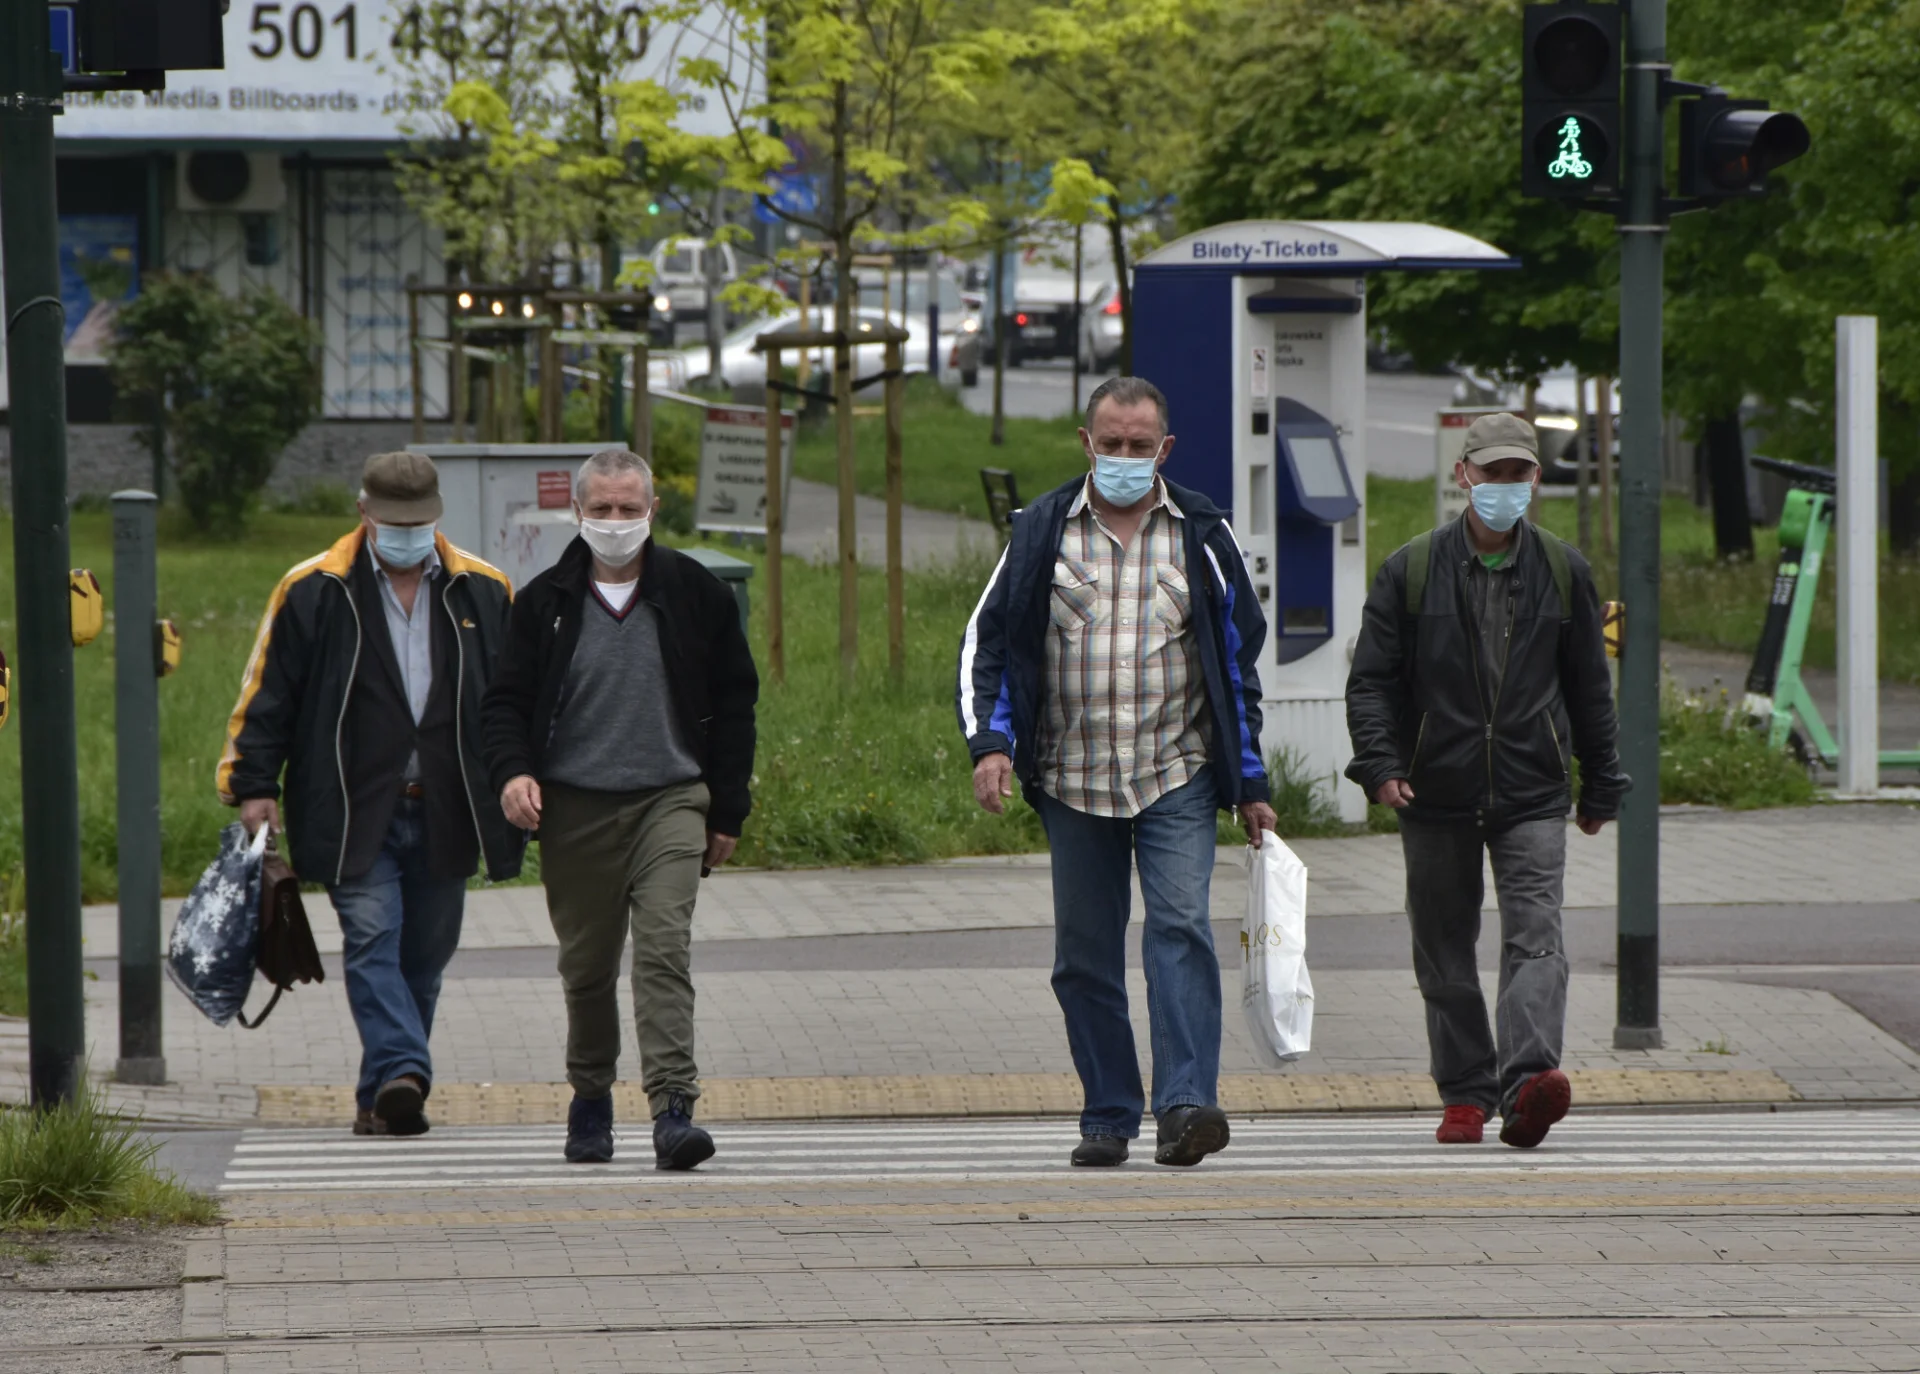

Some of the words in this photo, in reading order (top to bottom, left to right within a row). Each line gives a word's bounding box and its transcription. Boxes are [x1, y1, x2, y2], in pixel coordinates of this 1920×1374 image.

[249, 3, 356, 60] 501
[146, 87, 220, 111] Media
[228, 87, 359, 112] Billboards
[1192, 239, 1339, 263] Bilety-Tickets
